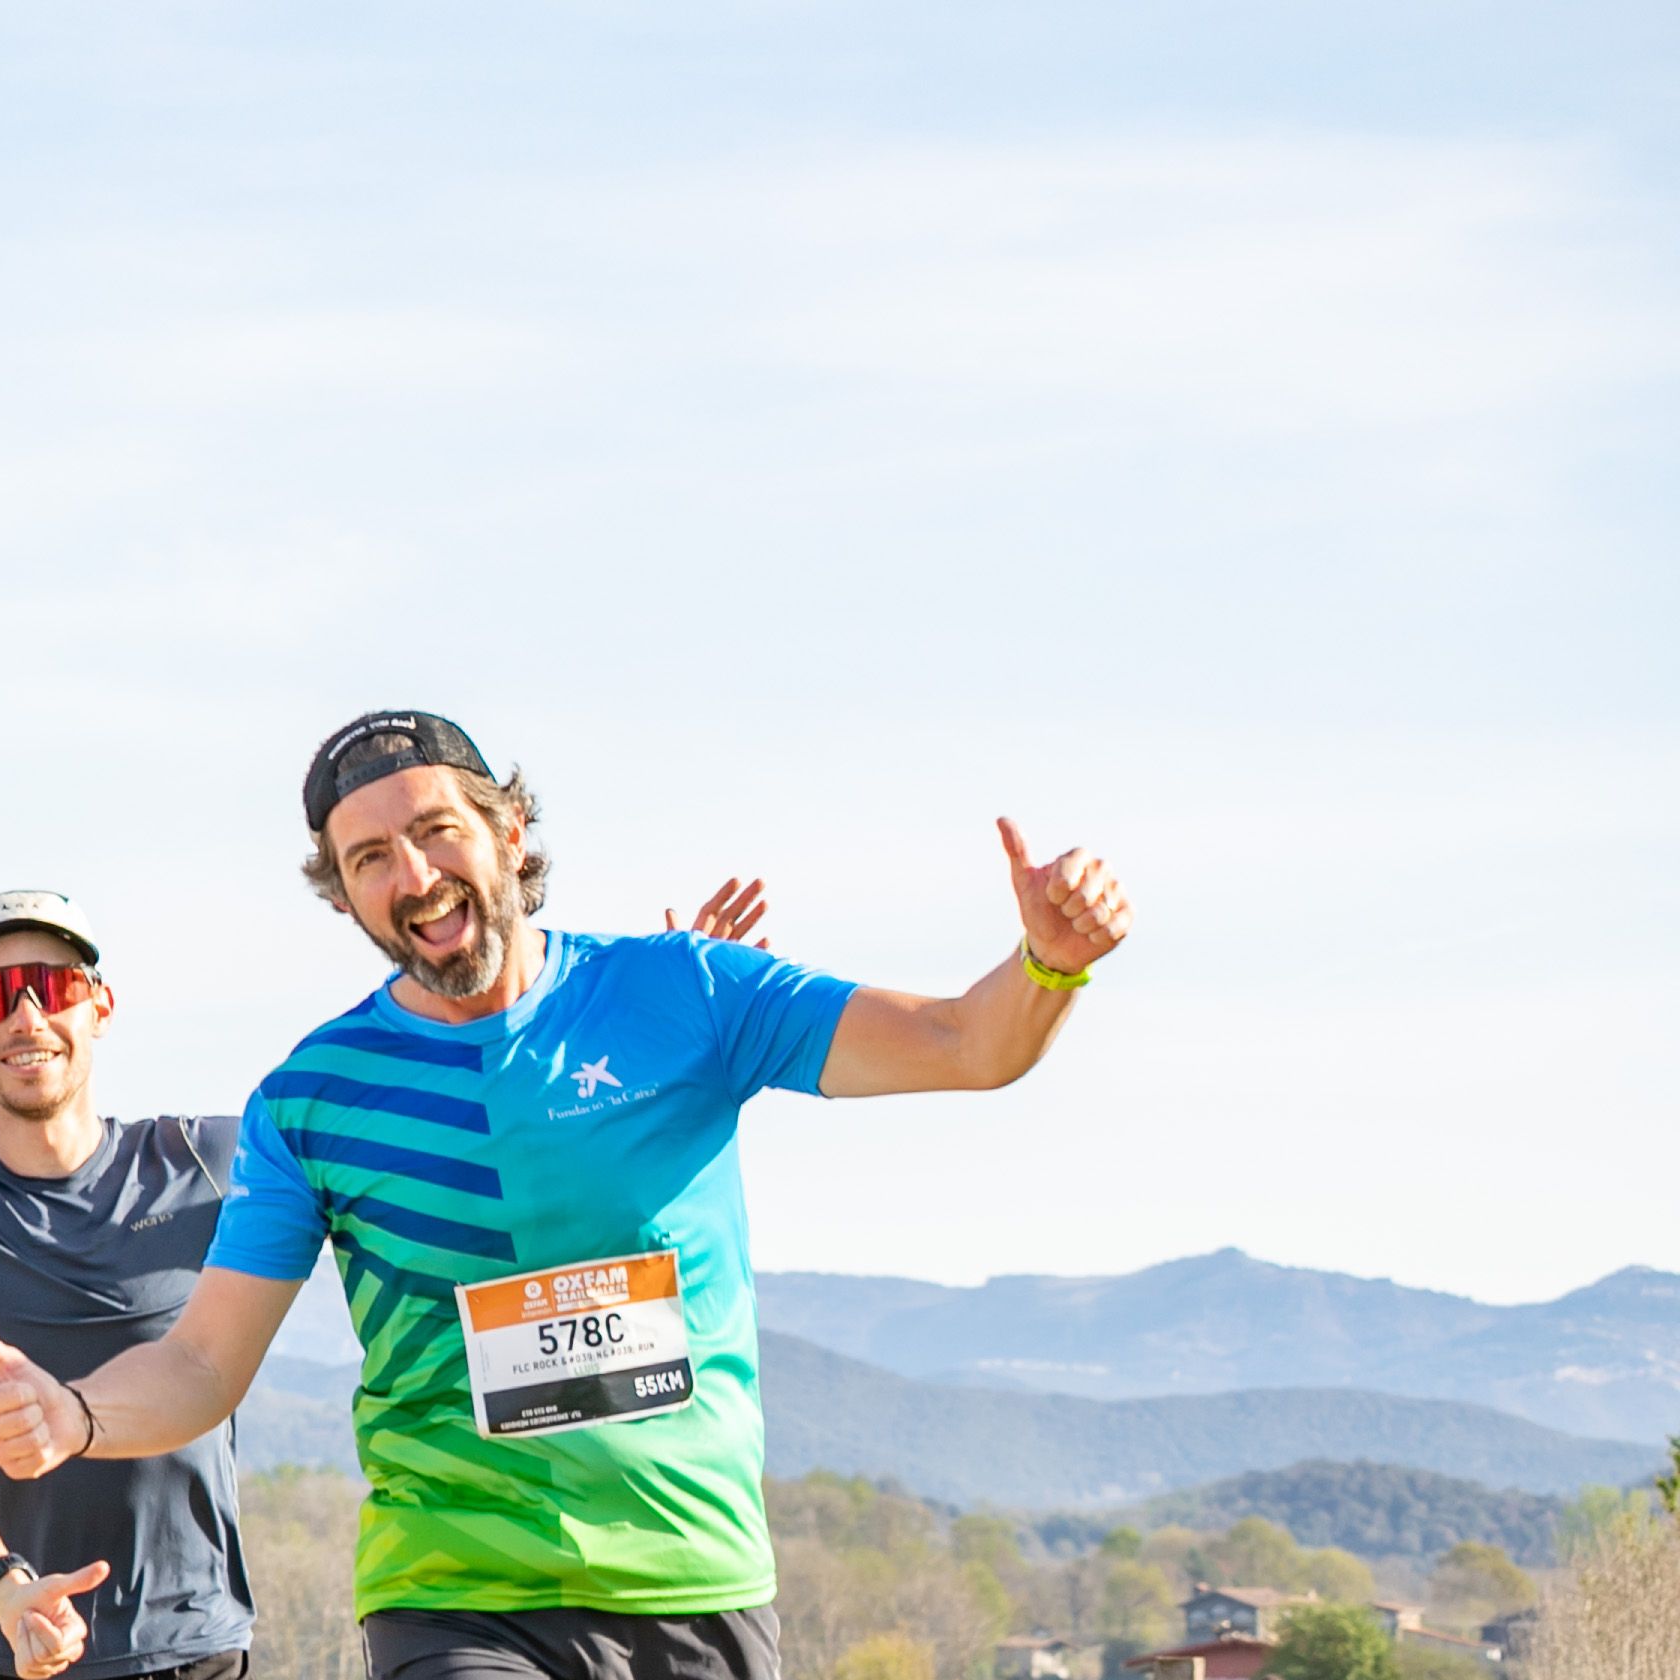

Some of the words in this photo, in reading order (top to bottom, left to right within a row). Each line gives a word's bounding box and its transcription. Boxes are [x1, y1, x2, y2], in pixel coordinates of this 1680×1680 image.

[553, 1266, 628, 1292] OXFAM
[554, 1283, 629, 1304] TRAILWALKER
[538, 1312, 625, 1355] 578C
[512, 1363, 530, 1374] FLC
[533, 1360, 558, 1371] ROCK
[638, 1343, 655, 1352] RUN
[634, 1369, 685, 1398] 55KM
